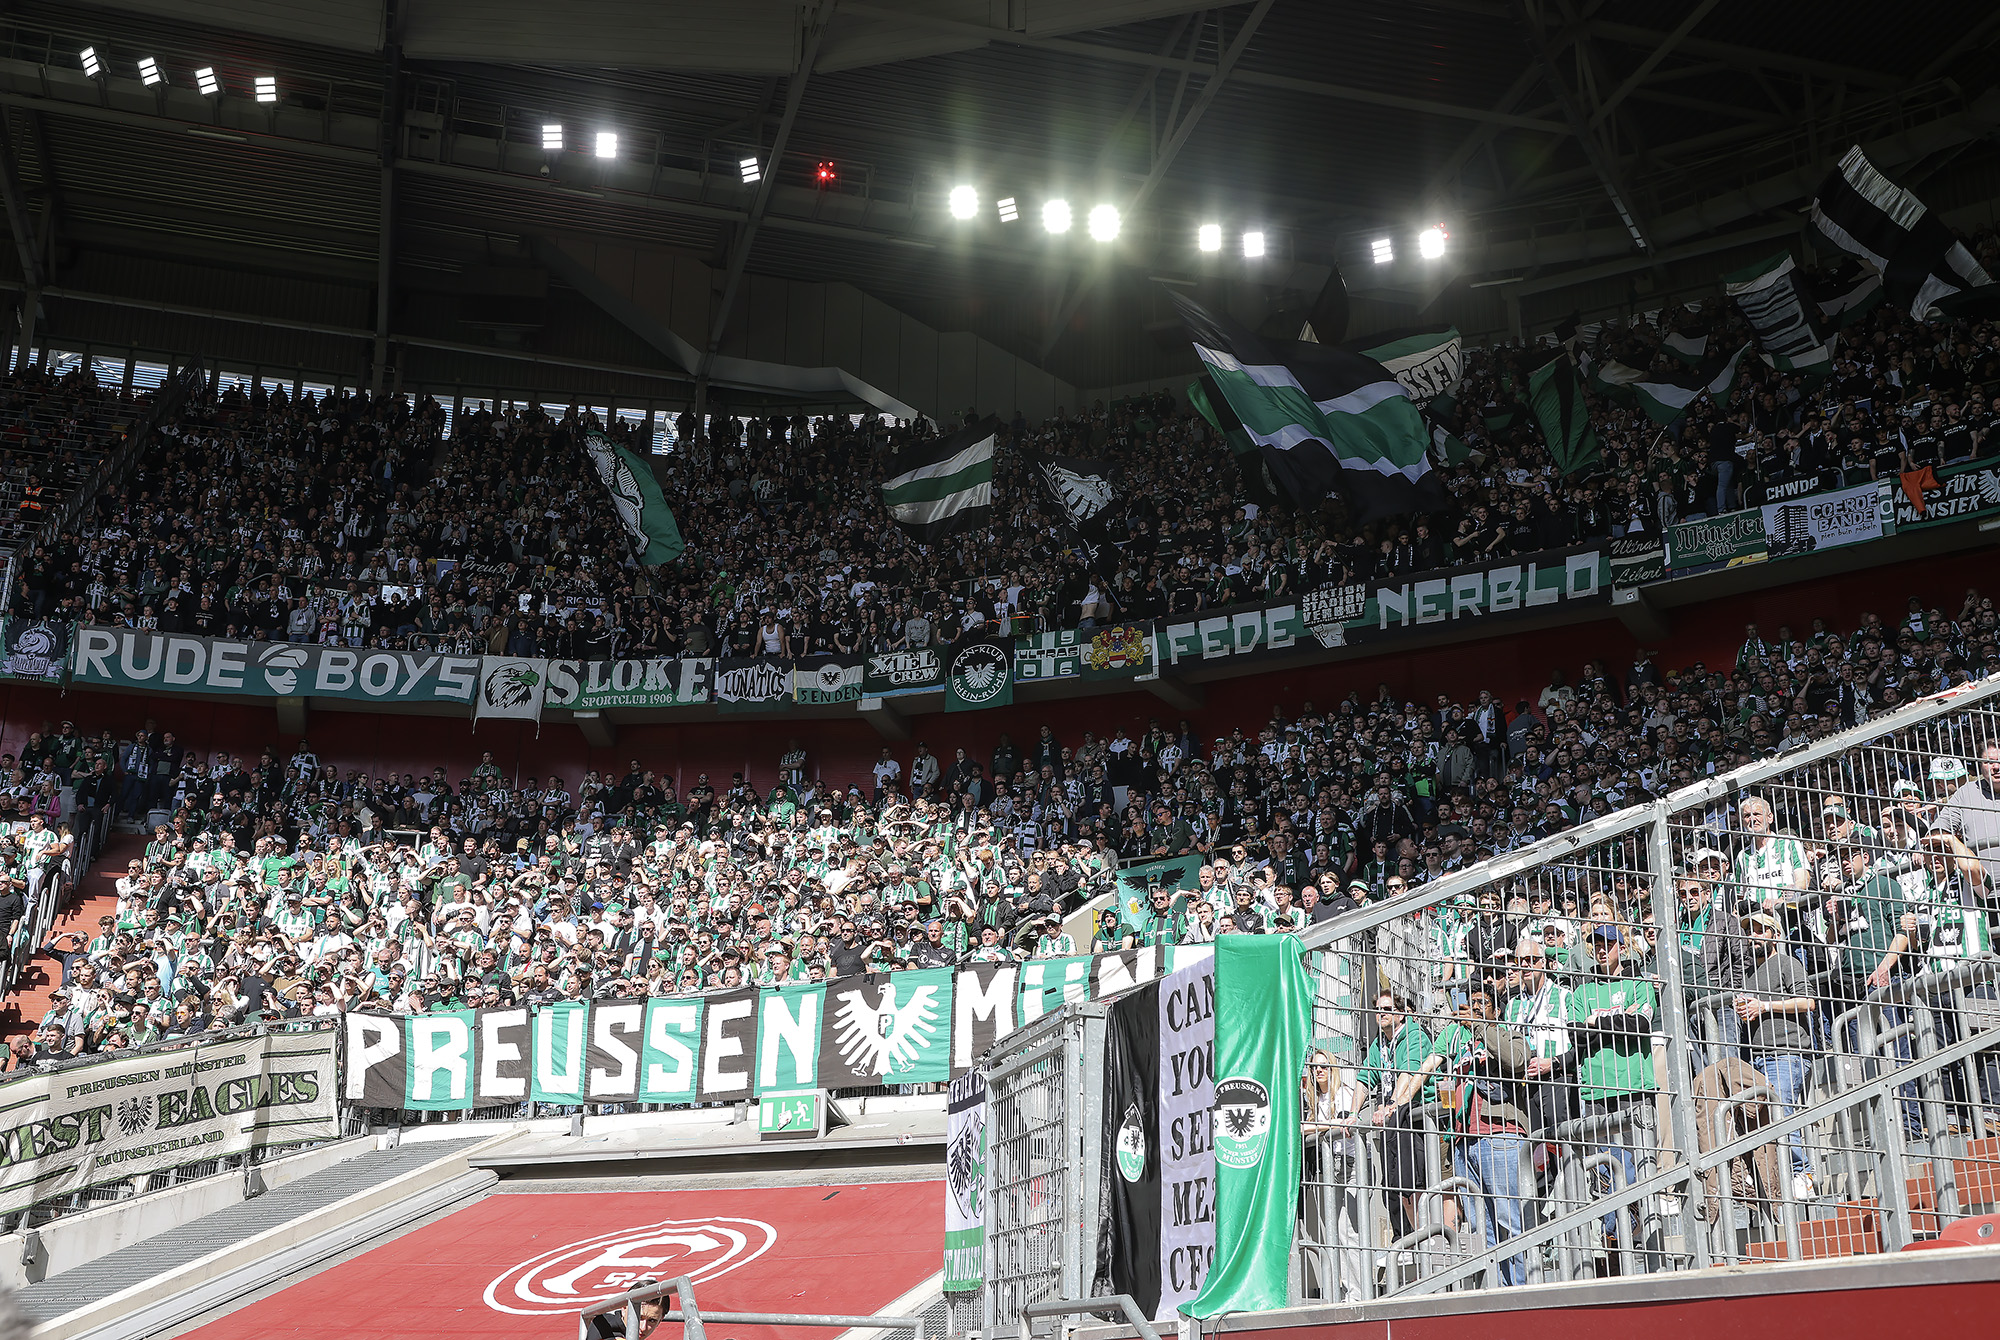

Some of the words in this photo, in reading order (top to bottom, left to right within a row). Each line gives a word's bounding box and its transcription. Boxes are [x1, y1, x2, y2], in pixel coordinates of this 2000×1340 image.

[1766, 476, 1819, 501] CHWDP
[1945, 474, 1978, 497] FÜR
[1810, 491, 1879, 520] COERDE
[1818, 508, 1875, 532] BANDE
[1675, 514, 1764, 552] Münster
[1610, 537, 1661, 555] Ultras
[1615, 566, 1662, 584] Liberi
[1303, 583, 1366, 603] SEKTION
[1303, 592, 1366, 612] STADION
[1167, 605, 1296, 665] FEDE
[1376, 551, 1600, 630] NERBLO
[1303, 602, 1365, 622] VERBOT
[955, 646, 1003, 668] FAN-KLUB
[1019, 646, 1079, 660] ULTRAS
[75, 630, 248, 688] RUDE
[315, 650, 479, 700] BOYS
[890, 667, 938, 683] CREW
[547, 657, 714, 704] SLOKE
[954, 671, 1006, 700] RHEIN-RUHR
[582, 694, 648, 707] SPORTCLUB
[649, 693, 673, 705] 1906
[802, 686, 863, 705] SENDEN
[345, 993, 827, 1100] PREUSSEN
[66, 1070, 160, 1099] PREUSSEN
[164, 1053, 247, 1080] MÜNSTER
[1220, 1082, 1261, 1094] PREUSSEN
[155, 1070, 320, 1130] EAGLES
[95, 1130, 225, 1168] MÜNSTERLAND
